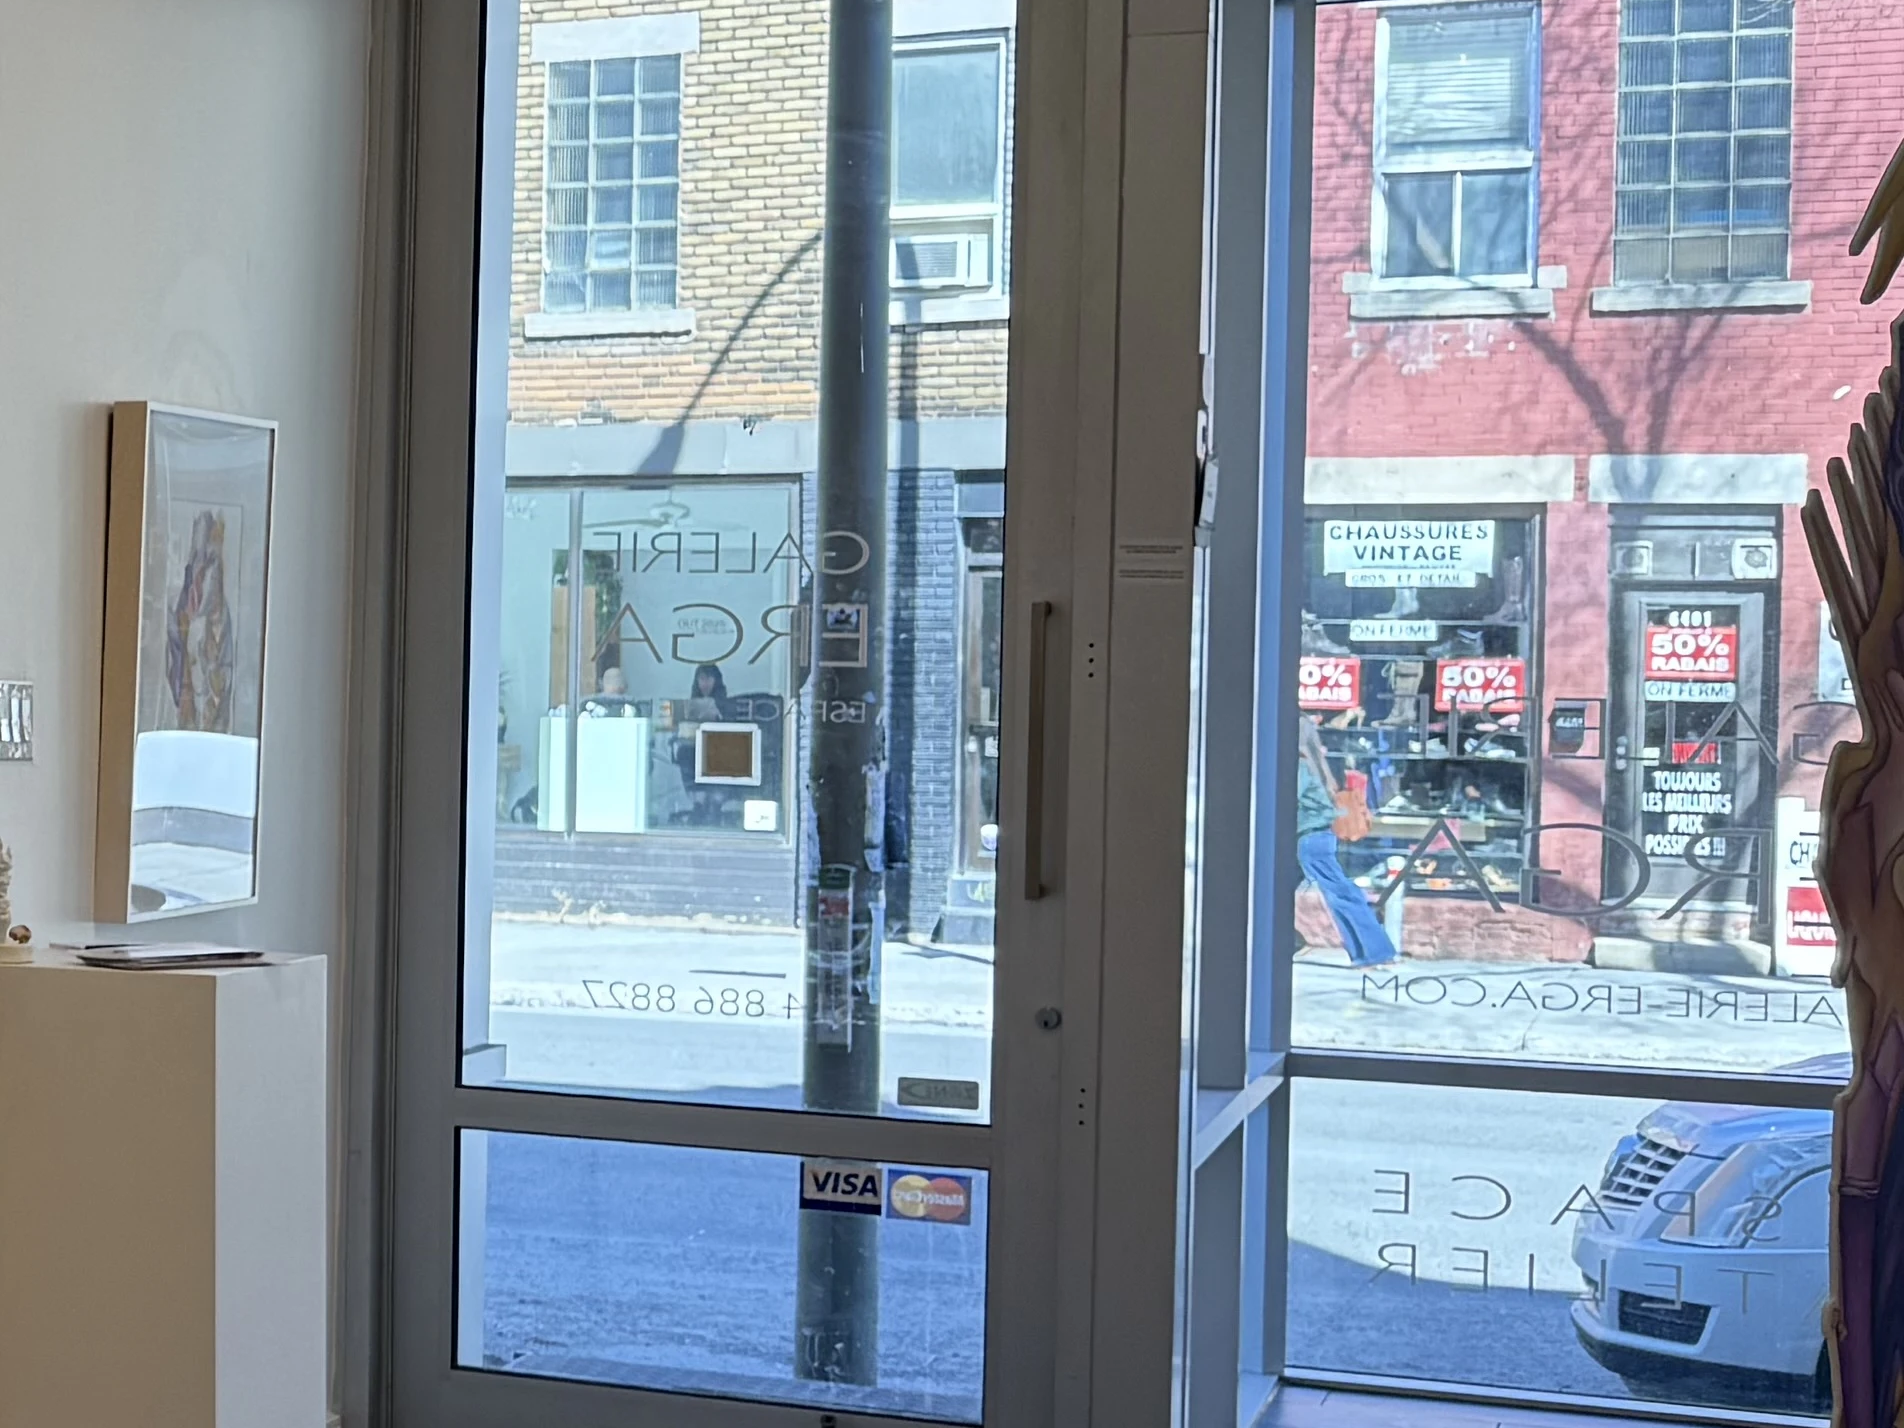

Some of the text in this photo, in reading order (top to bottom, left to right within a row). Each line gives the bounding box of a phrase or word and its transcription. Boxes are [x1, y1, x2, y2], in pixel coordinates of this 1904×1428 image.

[1329, 524, 1489, 541] CHAUSSURES
[1353, 544, 1463, 563] VINTAGE
[1651, 633, 1730, 657] 50%
[1651, 656, 1730, 672] RABAIS
[1299, 665, 1352, 687] 0%
[1441, 665, 1517, 688] 50%
[1652, 770, 1722, 793] TOUJOURS
[1642, 791, 1663, 813] LES
[1667, 813, 1705, 834] PRIX
[812, 1170, 879, 1198] VISA
